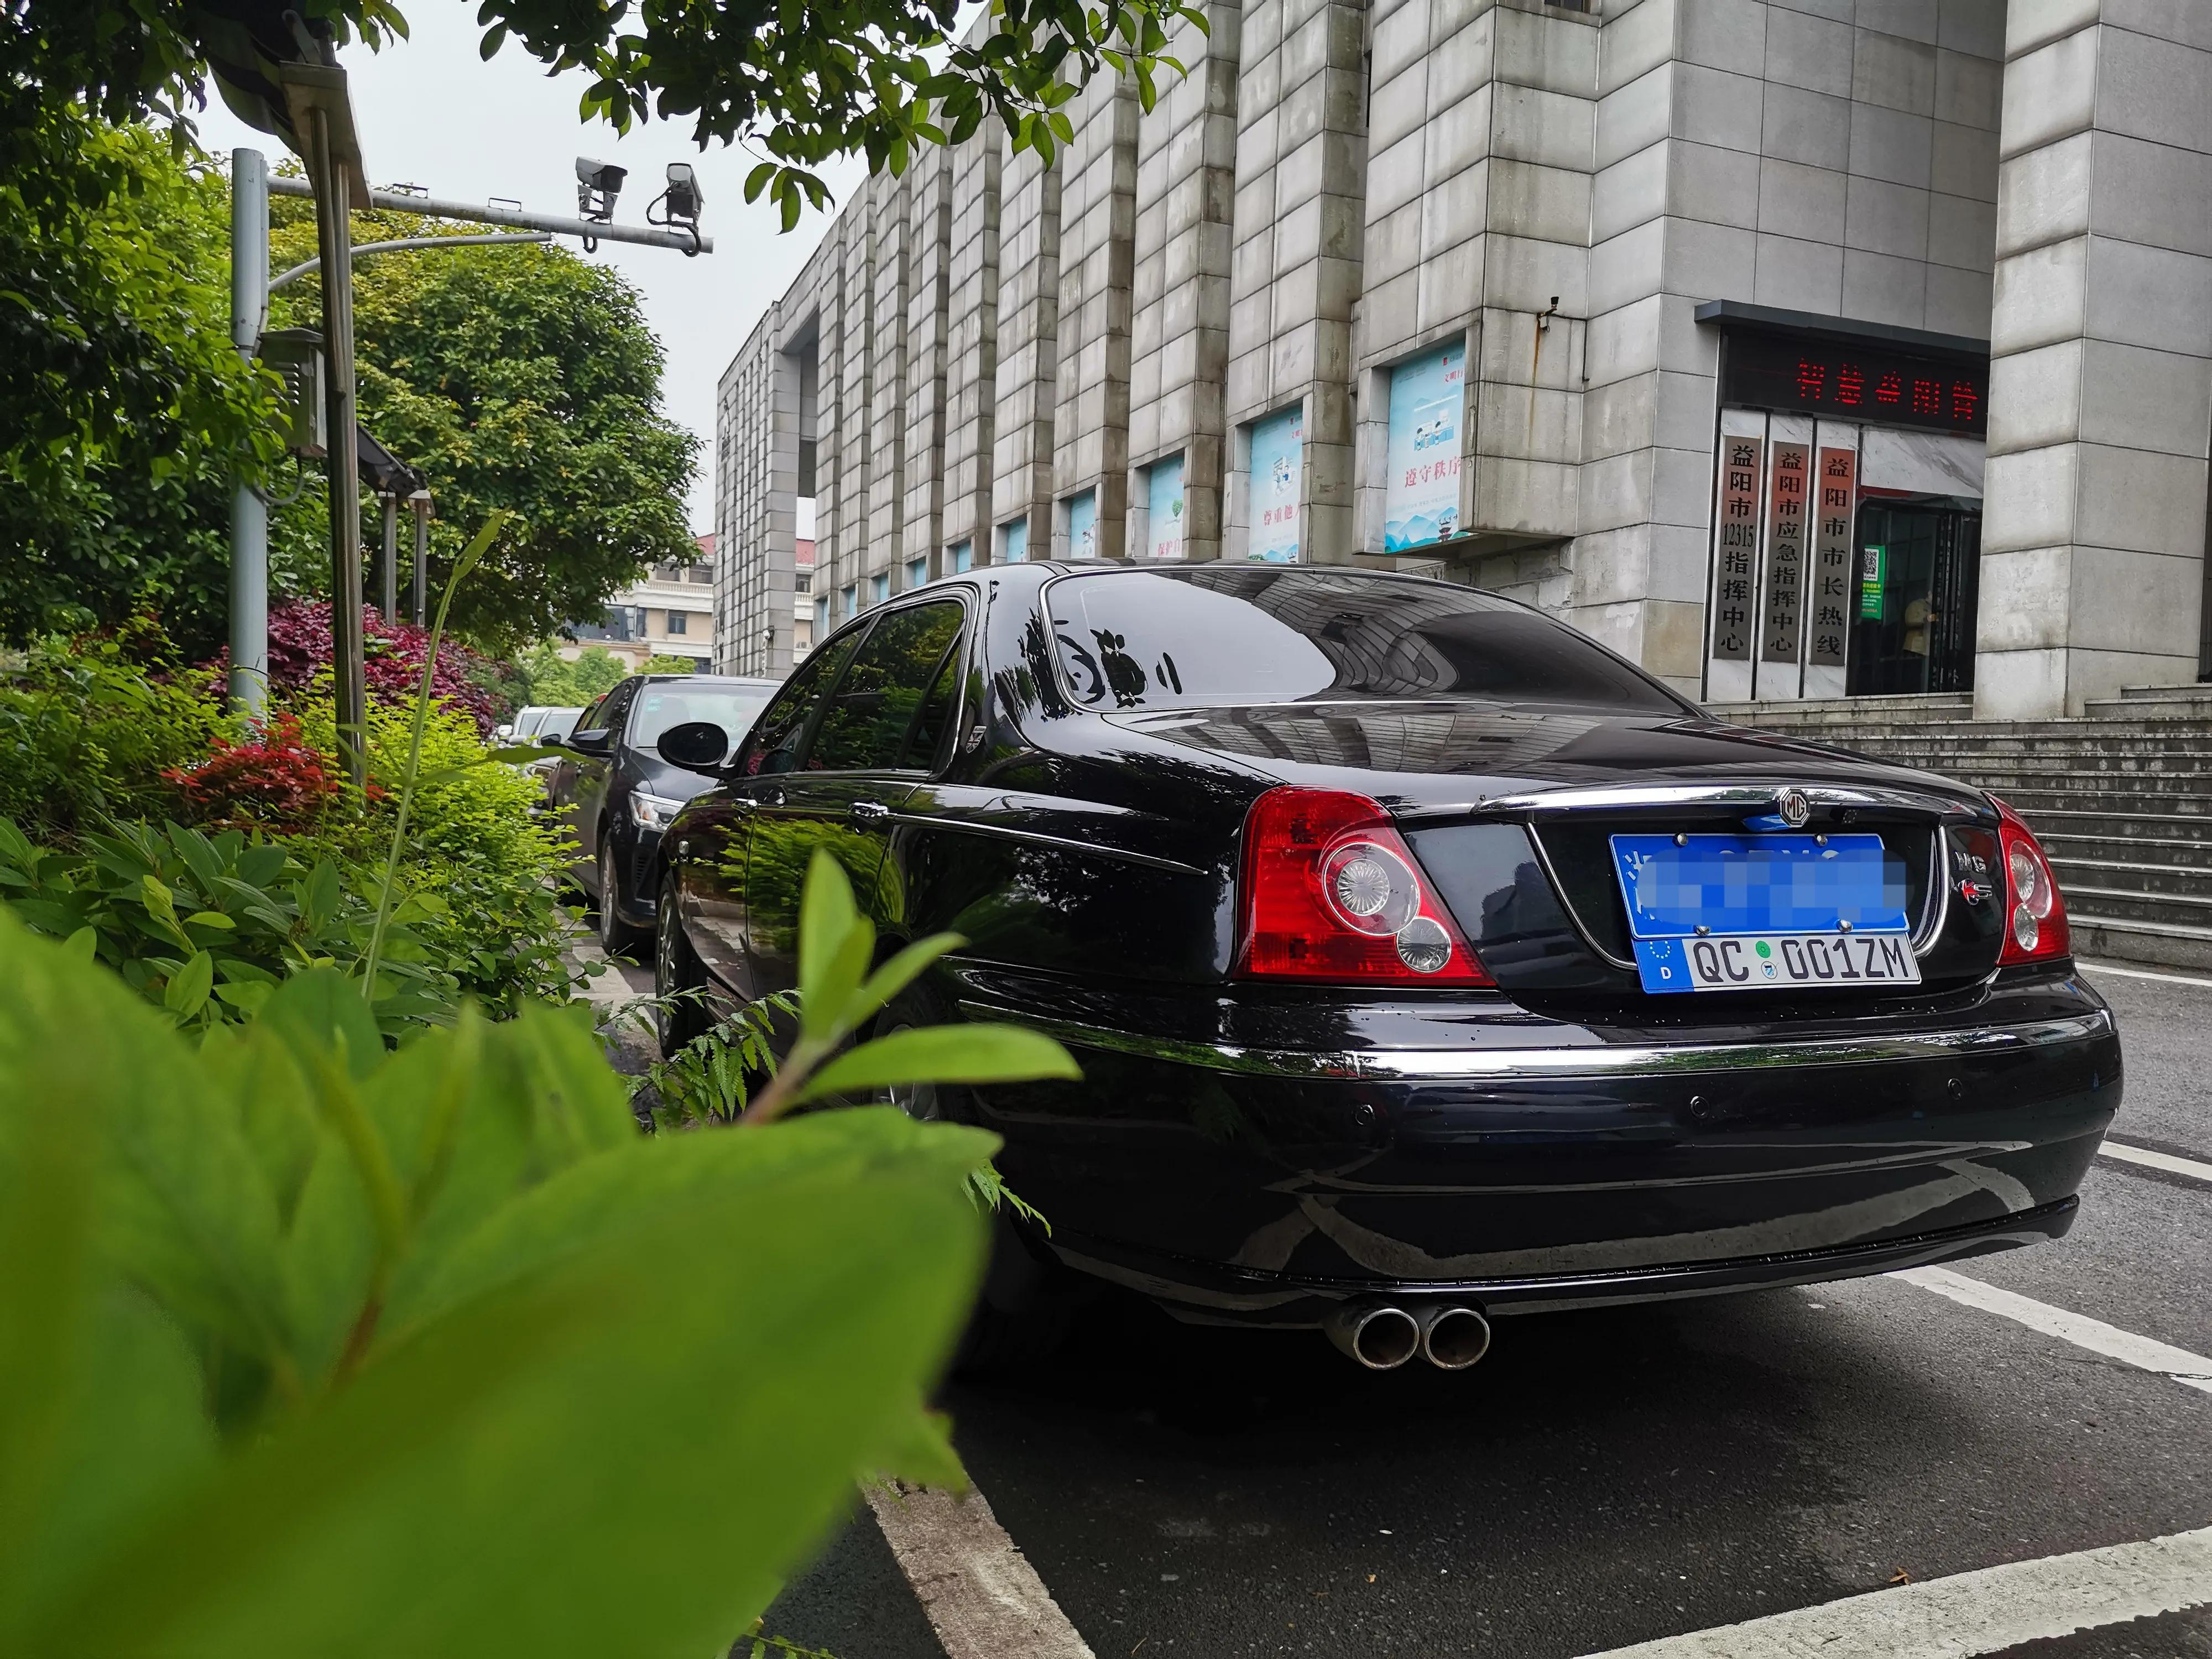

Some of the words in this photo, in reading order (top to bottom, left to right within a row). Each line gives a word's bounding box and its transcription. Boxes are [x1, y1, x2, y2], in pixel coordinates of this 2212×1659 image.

[1720, 445, 1755, 652] 益阳市12315指挥中心
[1770, 452, 1803, 653] 益阳市应急指挥中心
[1816, 457, 1849, 656] 益阳市市长热线
[1787, 795, 1805, 818] MG
[1661, 966, 1672, 980] D
[1692, 940, 1750, 983] QC
[1780, 938, 1910, 979] 001ZM
